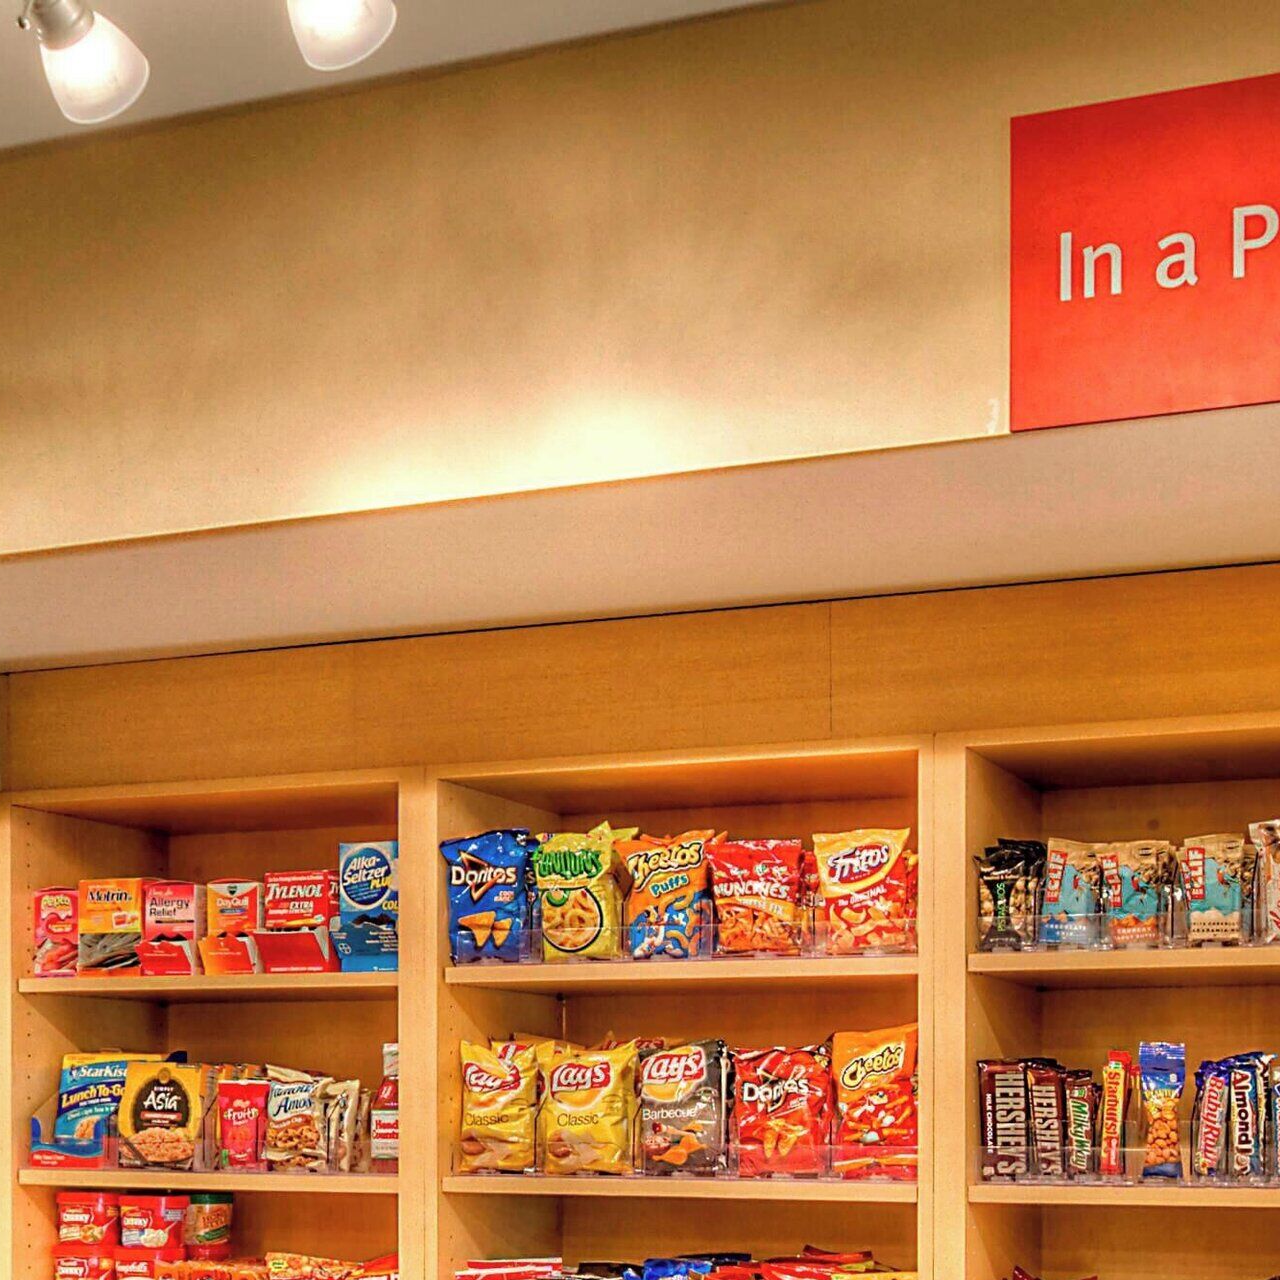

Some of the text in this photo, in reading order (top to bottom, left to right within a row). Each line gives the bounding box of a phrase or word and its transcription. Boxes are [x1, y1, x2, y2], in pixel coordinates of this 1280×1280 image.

[1058, 232, 1123, 302] In
[1155, 230, 1198, 290] a
[343, 864, 388, 886] Seltzer
[347, 856, 380, 871] Alka-
[451, 865, 517, 885] Doritos
[627, 842, 704, 890] Cheetos
[828, 845, 890, 883] Fritos
[266, 883, 324, 901] TYLENOL
[650, 873, 689, 897] Puffs
[149, 897, 190, 909] Allergy
[149, 905, 177, 917] Relief
[643, 1054, 701, 1084] Lay's
[842, 1044, 904, 1087] Cheetos
[552, 1064, 607, 1092] Lay's
[742, 1078, 809, 1102] Doritos
[61, 1086, 98, 1108] Lunch
[143, 1092, 178, 1111] Asia
[1202, 1076, 1225, 1121] Baby
[1232, 1070, 1252, 1144] Almond
[465, 1113, 510, 1127] Classic
[557, 1113, 599, 1127] Classic
[643, 1108, 697, 1121] Barbecue
[995, 1071, 1027, 1174] HERSHEY'S
[1032, 1085, 1062, 1175] HERSHEY'S
[1071, 1100, 1089, 1169] Milky Way
